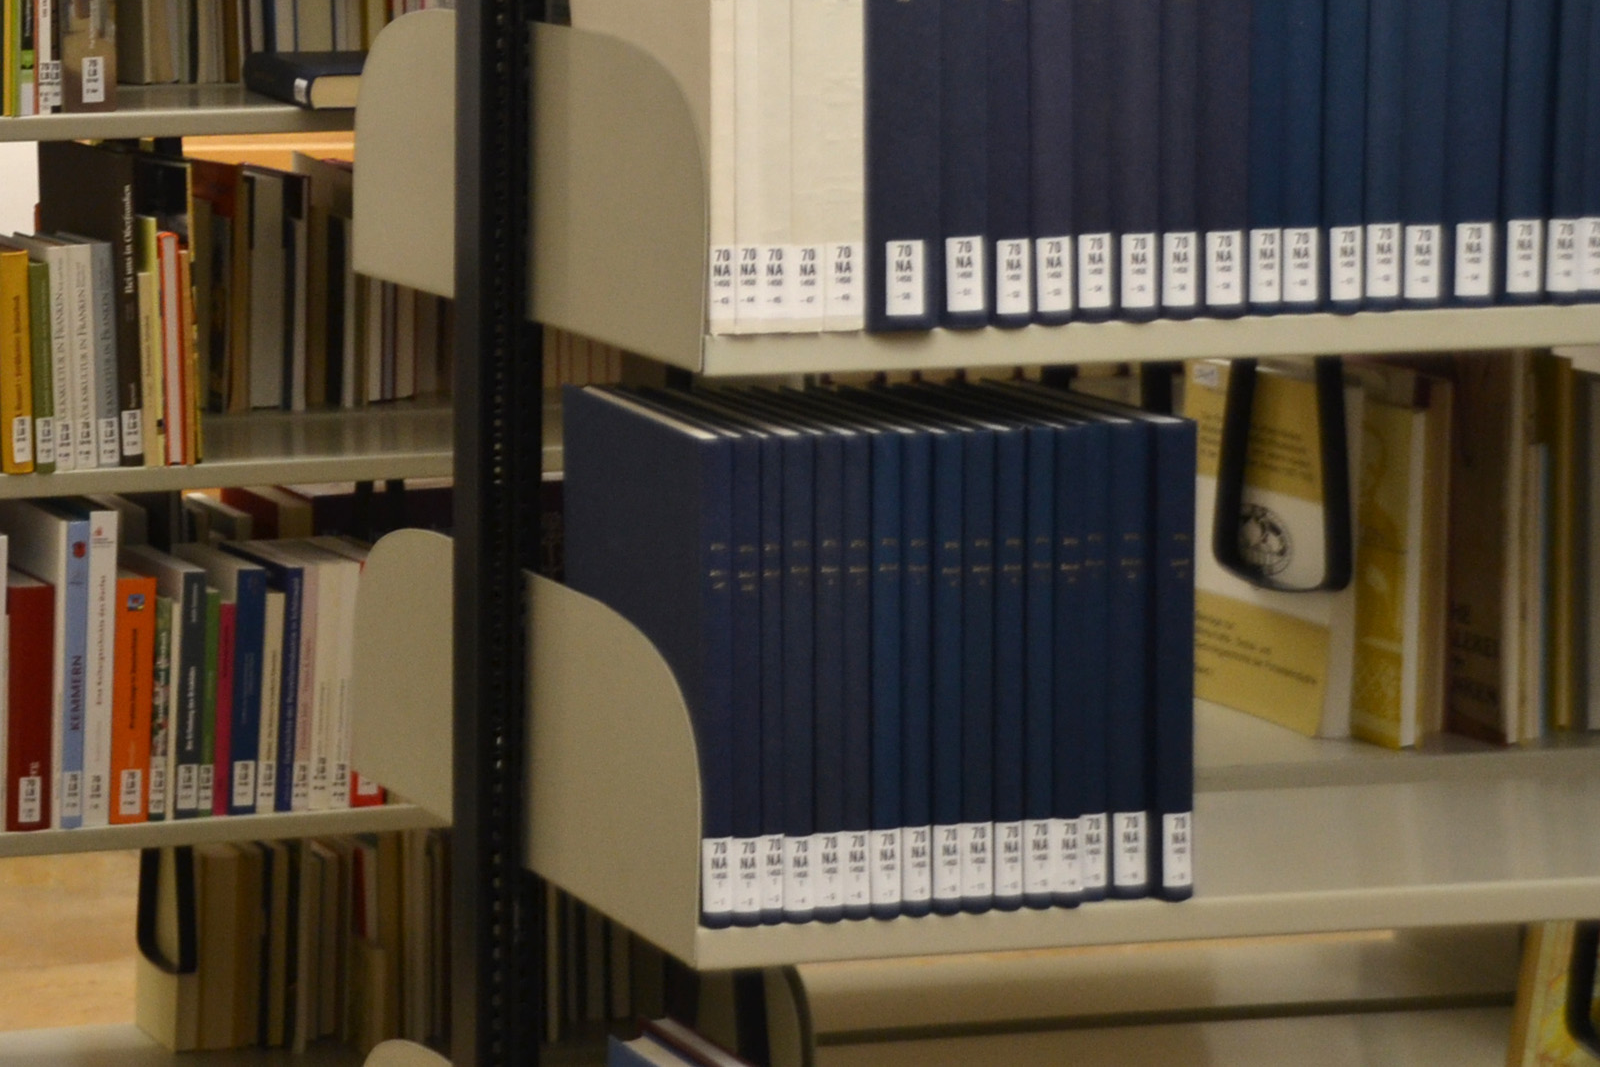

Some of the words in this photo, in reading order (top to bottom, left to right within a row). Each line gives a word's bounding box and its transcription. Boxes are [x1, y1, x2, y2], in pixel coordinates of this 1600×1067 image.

[1377, 227, 1393, 241] 70
[1467, 227, 1482, 240] 70
[1518, 223, 1534, 237] 70
[1559, 223, 1575, 237] 70
[1089, 237, 1104, 250] 70
[1133, 236, 1147, 250] 70
[1174, 236, 1189, 249] 70
[1217, 235, 1233, 248] 70
[1294, 232, 1310, 246] 70
[1516, 238, 1534, 251] NA
[1557, 237, 1575, 250] NA
[836, 245, 852, 259] 70
[896, 244, 912, 258] 70
[956, 240, 973, 254] 70
[1007, 243, 1022, 256] 70
[1047, 241, 1062, 254] 70
[1376, 242, 1393, 256] NA
[1465, 241, 1482, 255] NA
[714, 248, 731, 262] 70
[741, 247, 758, 261] 70
[767, 247, 784, 262] 70
[801, 248, 817, 262] 70
[1087, 252, 1104, 266] NA
[1131, 252, 1147, 266] NA
[1172, 251, 1189, 264] NA
[1215, 250, 1233, 263] NA
[1292, 248, 1309, 260] NA
[834, 261, 853, 274] NA
[895, 260, 913, 273] NA
[955, 256, 973, 269] NA
[1005, 258, 1022, 271] NA
[1046, 256, 1063, 269] NA
[713, 263, 731, 277] NA
[740, 263, 758, 277] NA
[766, 263, 784, 277] NA
[799, 263, 817, 277] NA
[69, 654, 82, 731] KEMMERN
[1125, 816, 1138, 829] 70
[1035, 823, 1049, 836] 70
[824, 836, 838, 849] 70
[852, 835, 865, 847] 70
[913, 830, 927, 843] 70
[1122, 831, 1139, 844] NA
[713, 842, 728, 854] 70
[742, 842, 756, 854] 70
[768, 838, 783, 851] 70
[1032, 838, 1049, 851] NA
[822, 852, 838, 864] NA
[849, 850, 865, 863] NA
[911, 846, 927, 858] NA
[711, 857, 728, 870] NA
[740, 857, 757, 870] NA
[766, 853, 783, 866] NA
